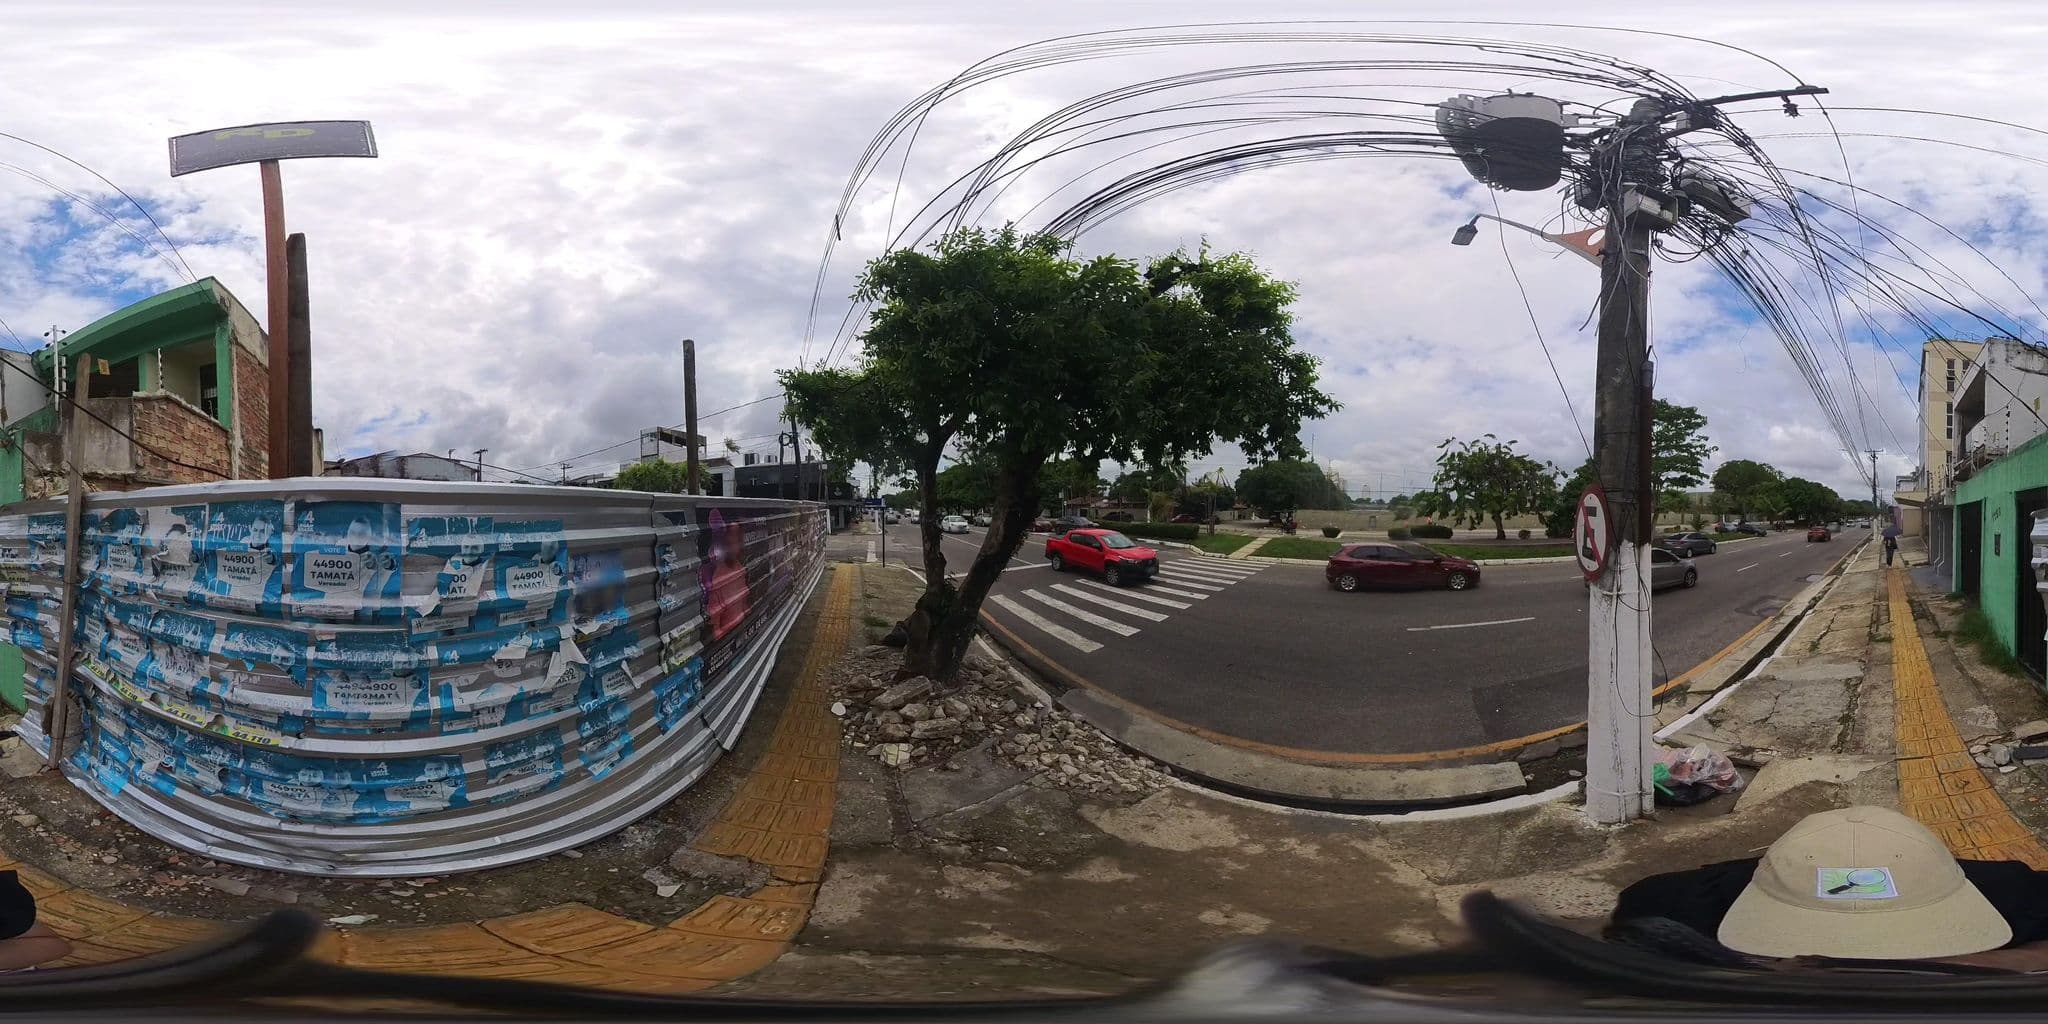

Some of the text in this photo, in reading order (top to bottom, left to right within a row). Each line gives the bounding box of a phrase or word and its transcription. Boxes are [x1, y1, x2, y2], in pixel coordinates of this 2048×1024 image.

[224, 554, 255, 564] 44900
[313, 559, 352, 569] 44900
[514, 571, 544, 581] 44900
